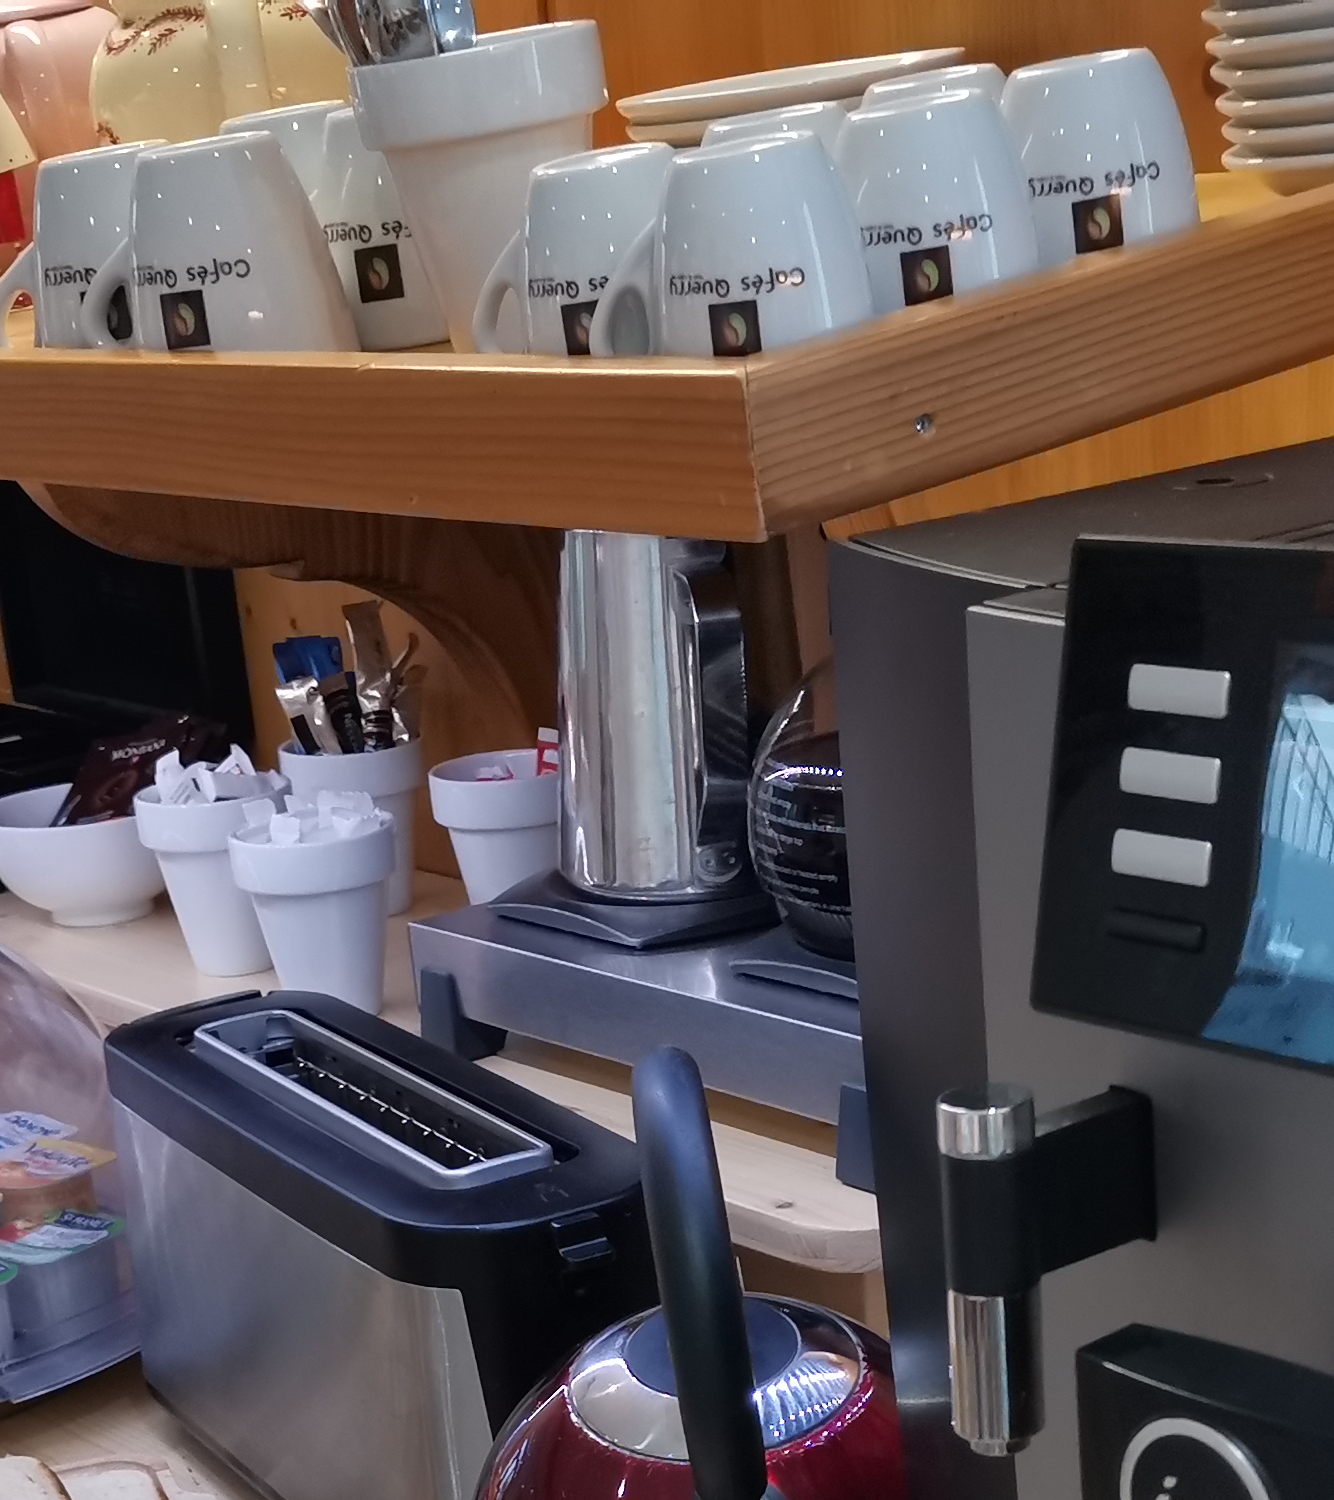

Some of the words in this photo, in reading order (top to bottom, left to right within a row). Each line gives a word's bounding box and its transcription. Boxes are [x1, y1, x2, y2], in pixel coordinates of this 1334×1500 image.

[1028, 176, 1095, 197] Querry
[186, 258, 250, 287] Cafés
[741, 267, 806, 294] Cafés
[669, 275, 730, 298] Querry
